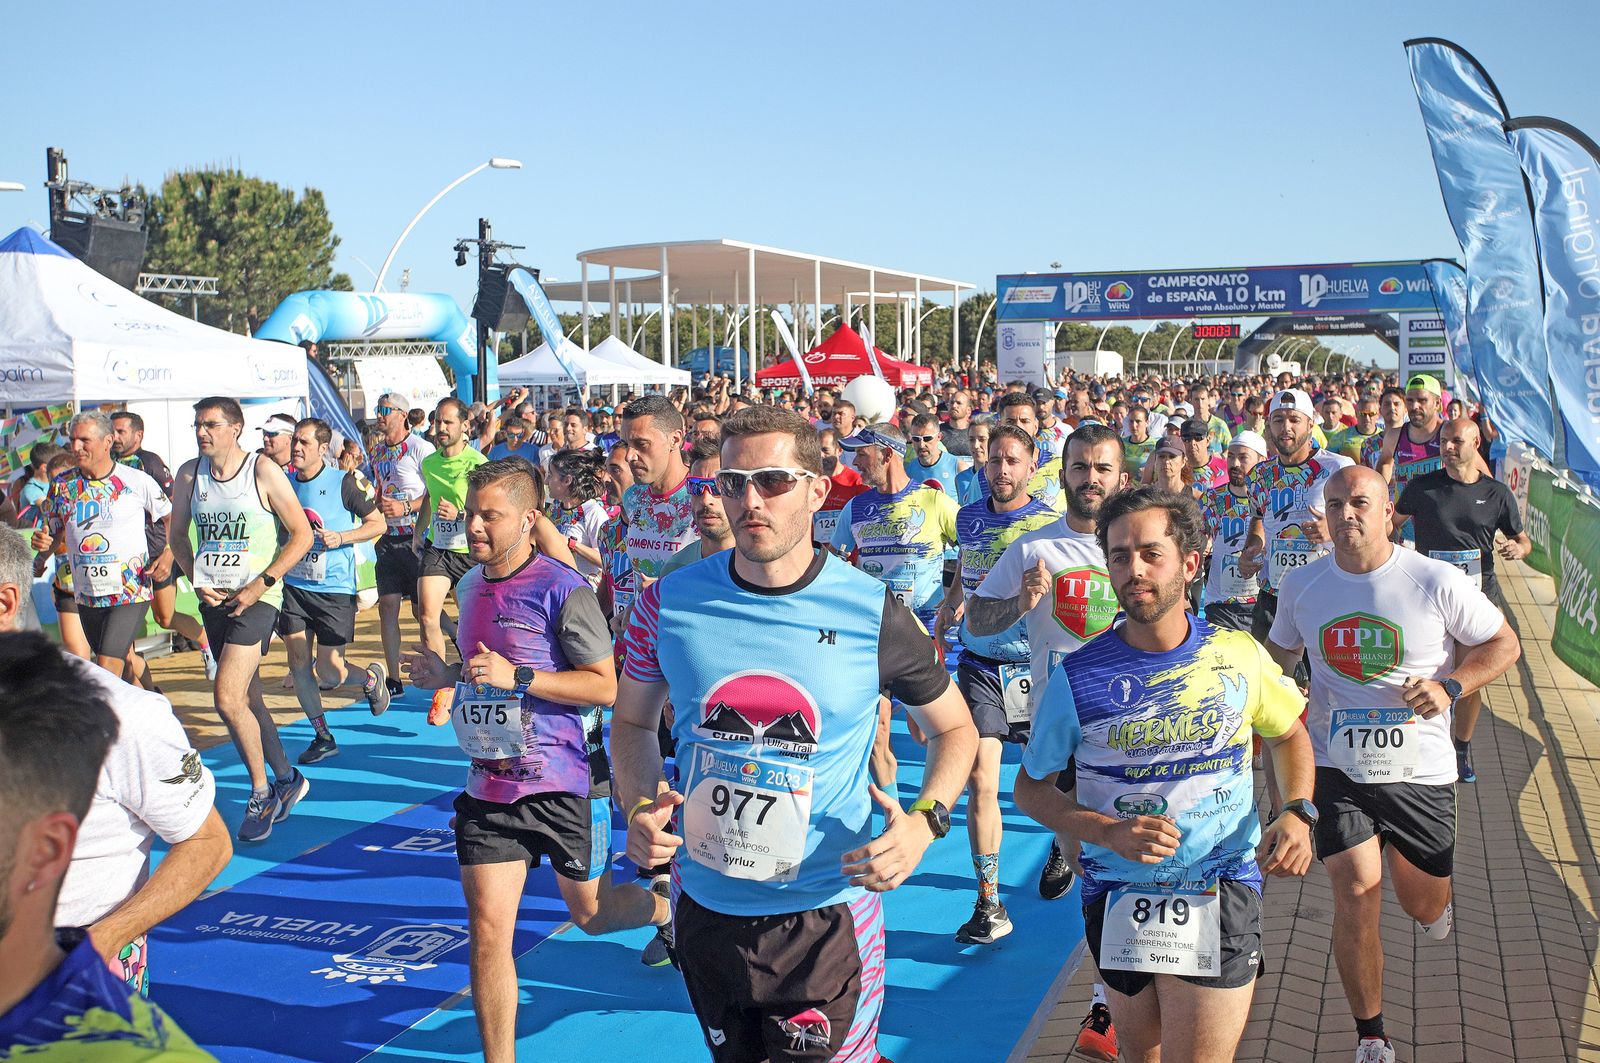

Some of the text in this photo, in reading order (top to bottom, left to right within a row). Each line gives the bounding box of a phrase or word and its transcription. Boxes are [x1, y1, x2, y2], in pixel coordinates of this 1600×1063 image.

[1148, 273, 1249, 287] CAMPEONATO
[1327, 279, 1369, 293] HUELVA
[1147, 284, 1285, 303] de ESPAÑA 10 km
[1250, 304, 1255, 312] y
[1258, 302, 1285, 310] Master
[1293, 323, 1313, 331] Huelva
[198, 523, 250, 541] TRAIL
[436, 522, 459, 533] 1531
[857, 522, 907, 539] HERMES
[663, 541, 682, 552] FIT
[203, 553, 240, 567] 1722
[1274, 552, 1308, 567] 1633
[82, 565, 108, 577] 736
[893, 582, 912, 590] 2023
[1063, 577, 1118, 601] TPL
[1057, 602, 1079, 611] JORGE
[1331, 627, 1392, 649] TPL
[461, 704, 508, 725] 1575
[1385, 712, 1409, 722] 2023
[1107, 709, 1224, 751] HERMES
[767, 737, 813, 754] Ultra Trail
[1343, 728, 1404, 749] 1700
[778, 750, 810, 761] HUELVA
[713, 758, 738, 775] HUELVA
[1124, 756, 1234, 778] PALOS DE LA FRONTERA
[1367, 769, 1391, 777] Syrluz
[766, 769, 801, 789] 2023
[710, 784, 777, 826] 977
[725, 826, 749, 840] JAIME
[705, 832, 770, 854] GALVEZ RAPOSO
[722, 852, 756, 868] Syrluz
[1178, 879, 1207, 891] 2023
[1132, 897, 1190, 925] 819
[219, 911, 373, 937] HUELVA
[194, 924, 346, 946] Ayuntamiento de
[1142, 930, 1178, 939] CRISTIAN
[1173, 942, 1195, 950] TOME
[1110, 956, 1143, 964] HYUNDAI
[1149, 952, 1180, 964] Syrluz
